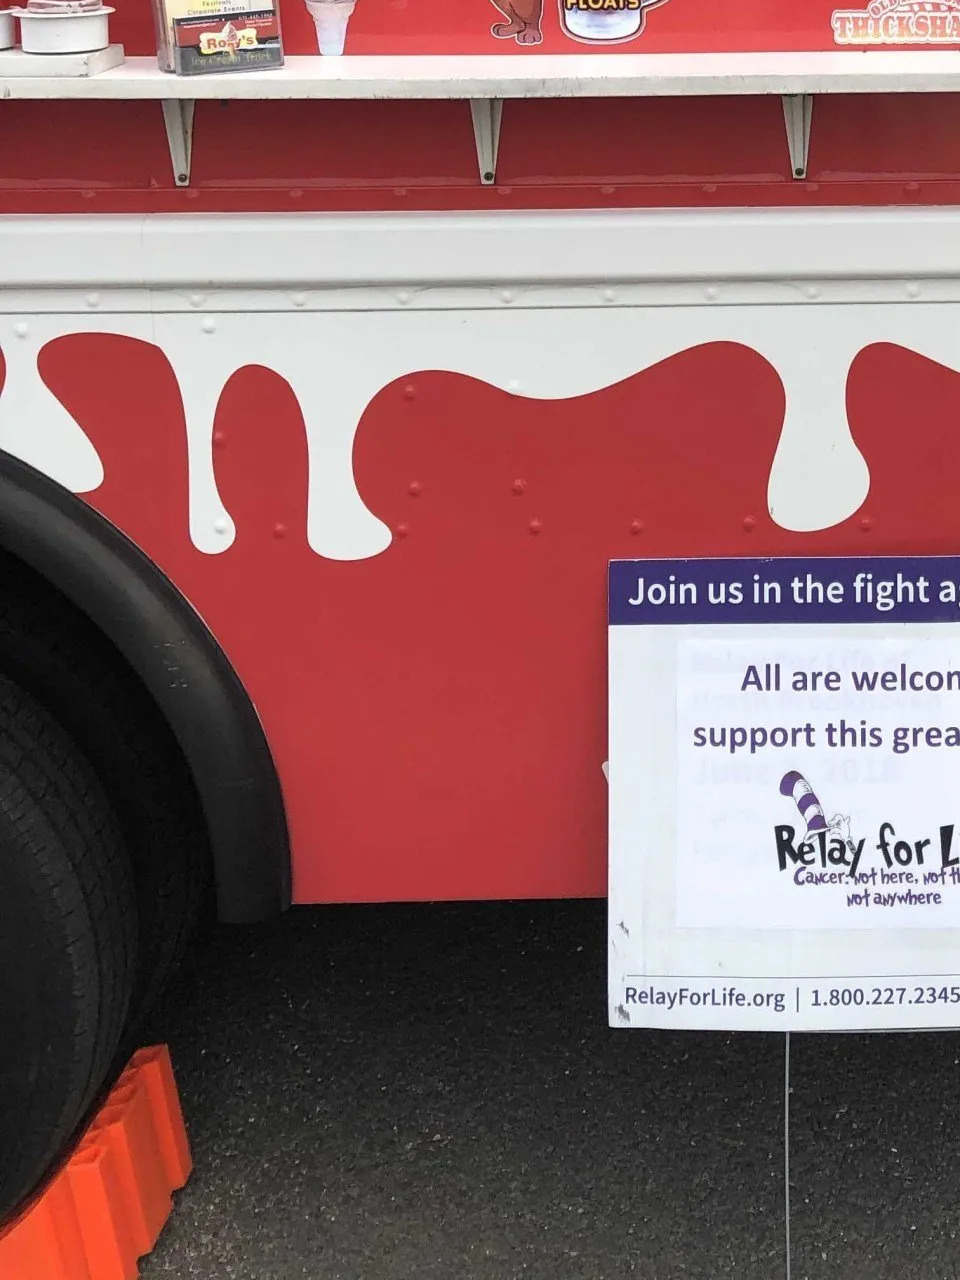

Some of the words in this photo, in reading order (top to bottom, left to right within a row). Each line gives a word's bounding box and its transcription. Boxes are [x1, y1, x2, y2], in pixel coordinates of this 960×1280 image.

[628, 575, 697, 605] Join
[708, 580, 744, 604] us
[753, 574, 781, 604] in
[791, 574, 844, 604] the
[854, 573, 930, 611] fight
[741, 664, 780, 691] All
[792, 670, 841, 691] are
[693, 723, 815, 753] support
[826, 720, 884, 748] this
[774, 824, 866, 878] Relay
[876, 822, 931, 868] for
[847, 889, 870, 907] not
[874, 889, 942, 906] anywhere
[625, 987, 786, 1012] RelayForLife.org
[811, 987, 960, 1007] 1.800.227.2345
